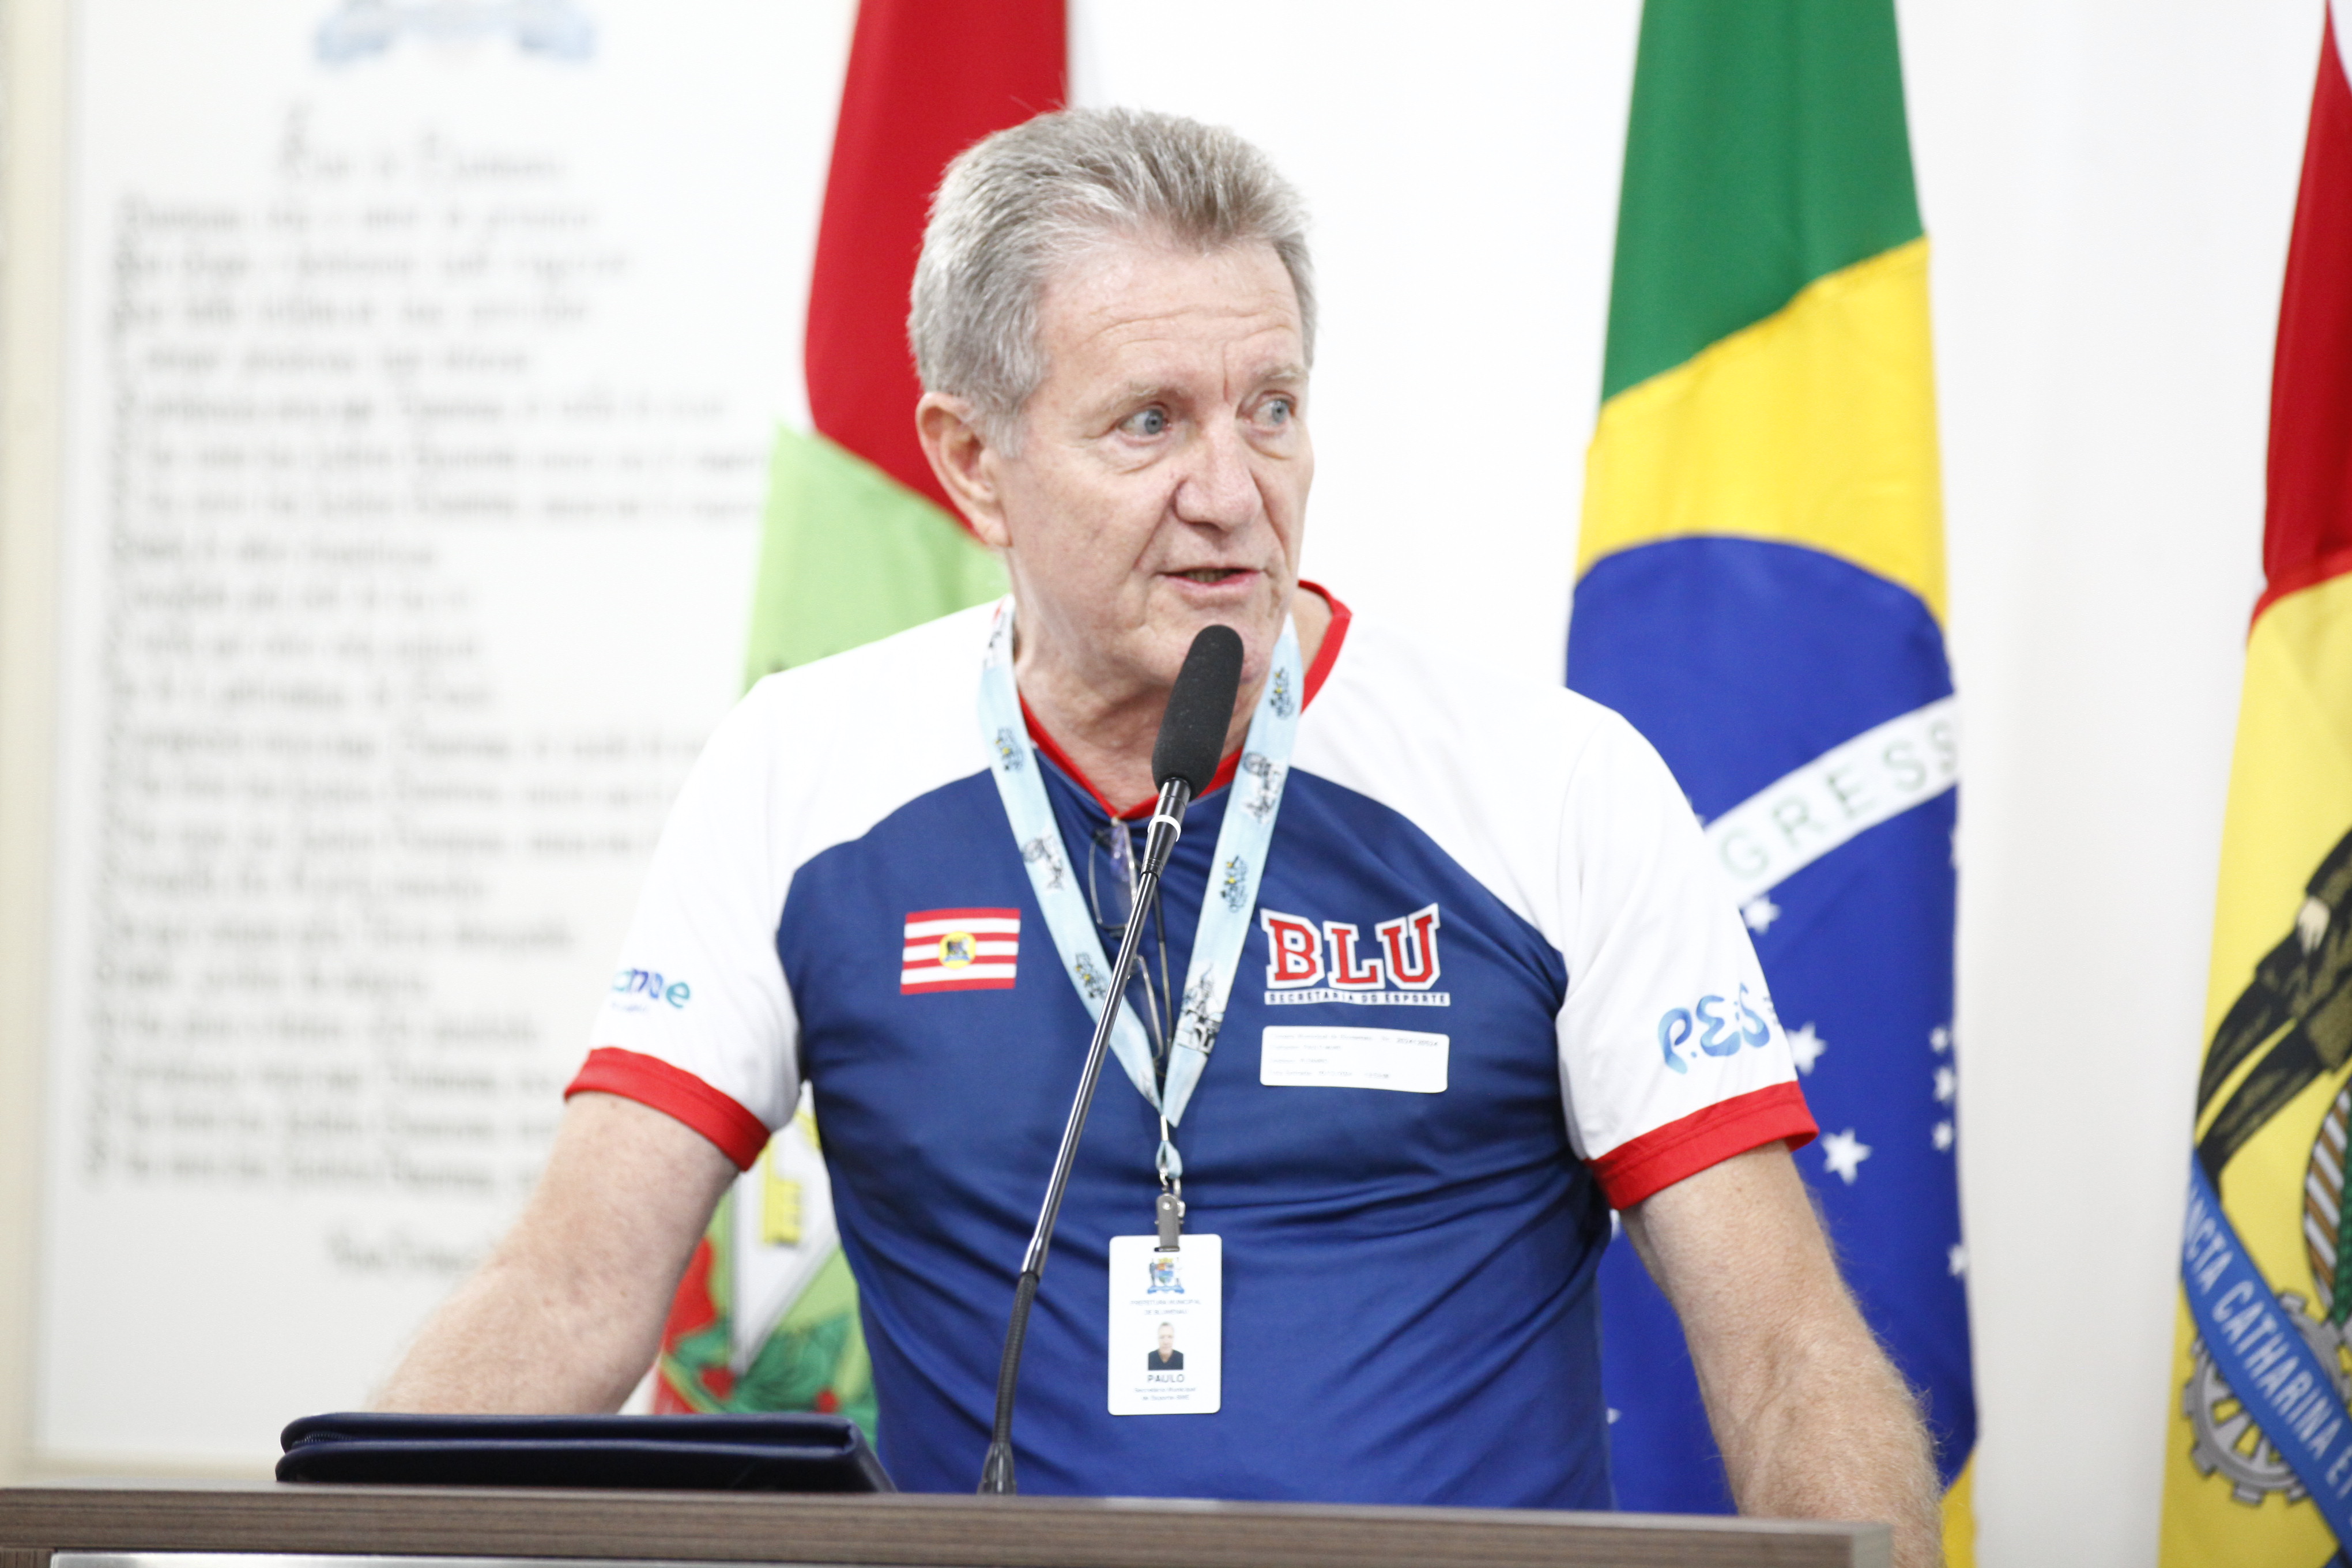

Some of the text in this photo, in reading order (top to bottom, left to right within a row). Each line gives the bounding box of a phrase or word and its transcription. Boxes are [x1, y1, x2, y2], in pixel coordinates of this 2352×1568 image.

[1260, 902, 1441, 990] BLU
[1269, 990, 1445, 1004] SECRETARIA DO ESPORTE
[1147, 1374, 1185, 1383] PAULO
[2212, 1280, 2343, 1462] CATHARINA
